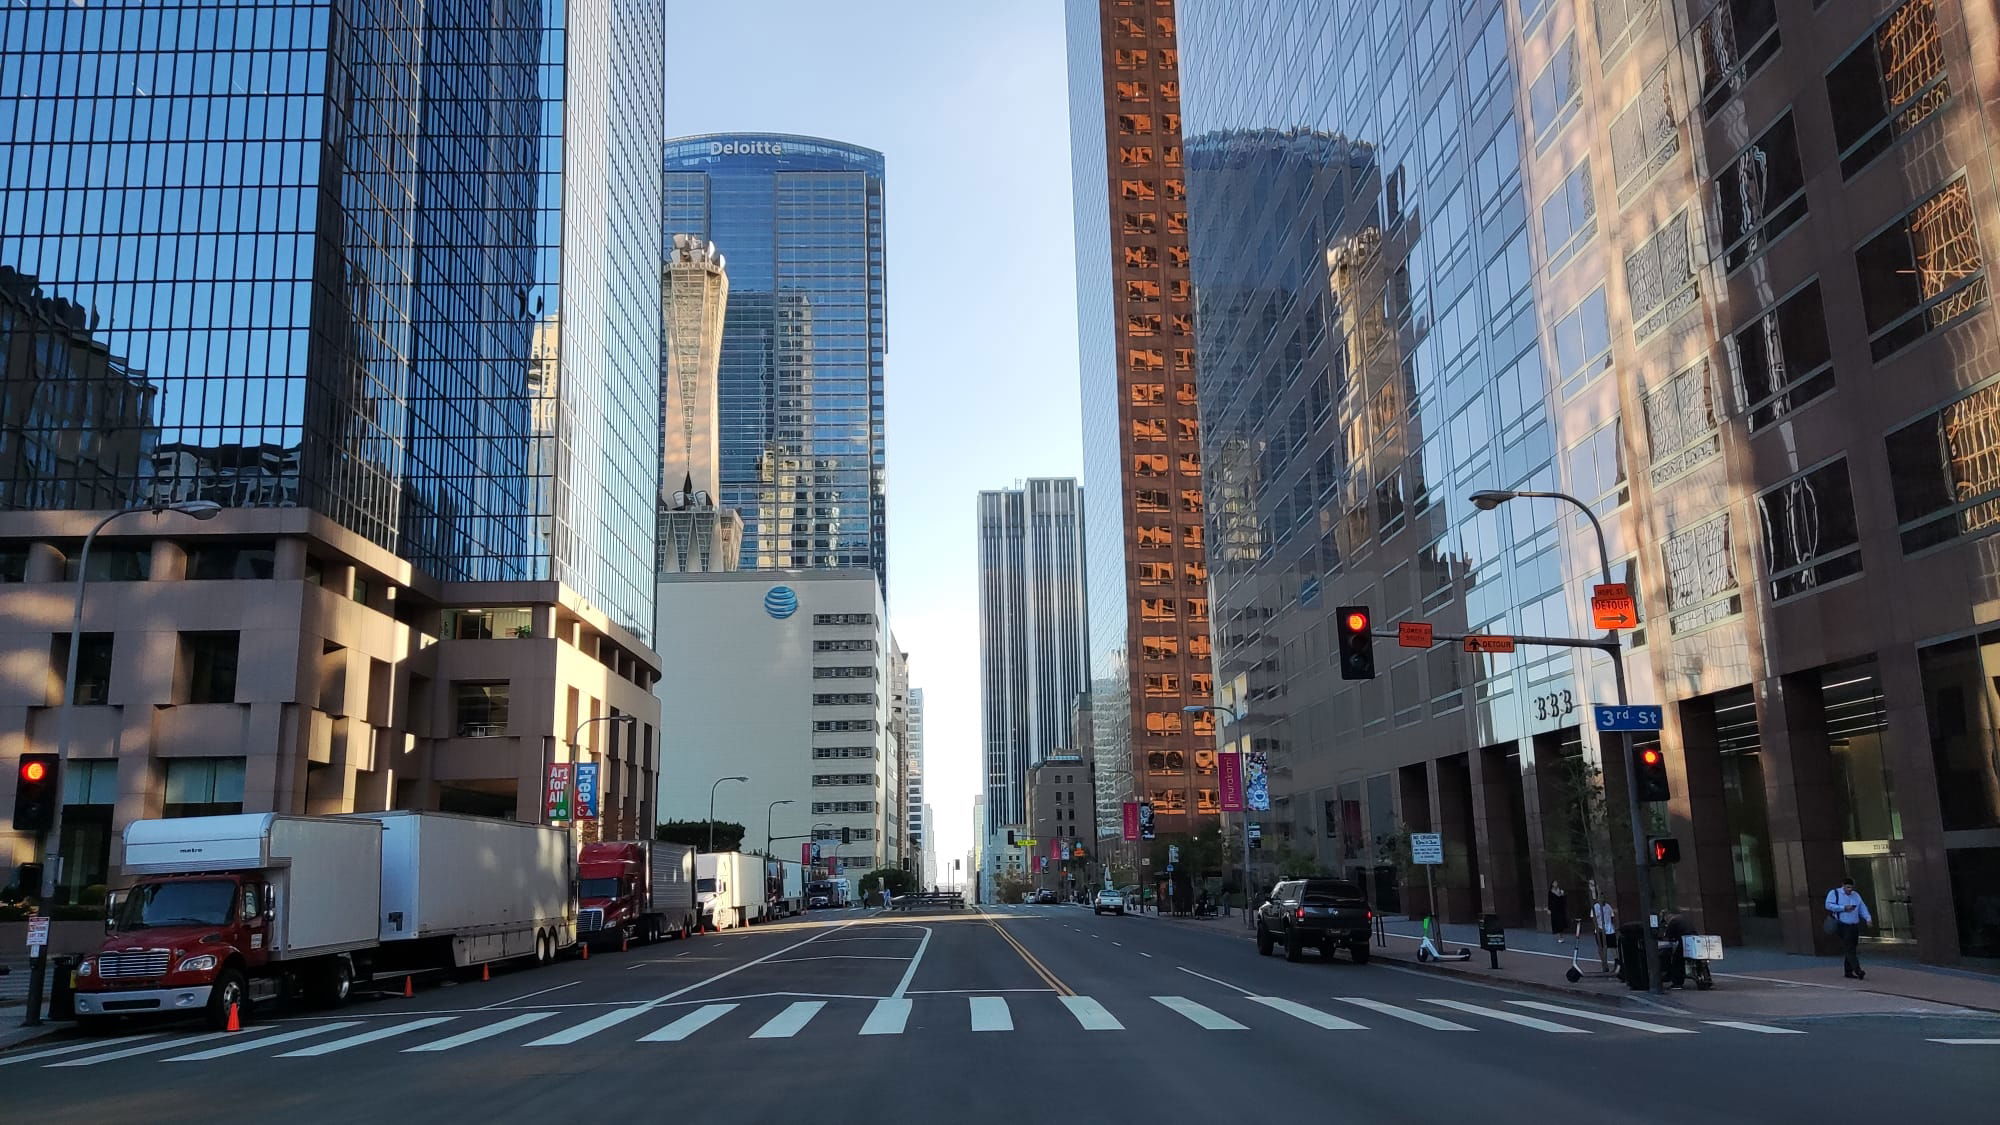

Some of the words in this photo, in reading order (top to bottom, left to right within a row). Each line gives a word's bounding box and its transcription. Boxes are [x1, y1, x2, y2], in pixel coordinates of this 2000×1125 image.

[710, 141, 782, 156] Deloitte
[1595, 601, 1630, 610] DETOUR
[1482, 640, 1511, 648] DETOUR
[1533, 689, 1573, 720] 333
[1602, 710, 1629, 726] 3rd
[1638, 711, 1657, 724] St
[550, 767, 568, 779] Art
[1224, 757, 1234, 802] murakami
[549, 779, 567, 790] for
[578, 766, 597, 802] Free
[548, 791, 564, 803] All
